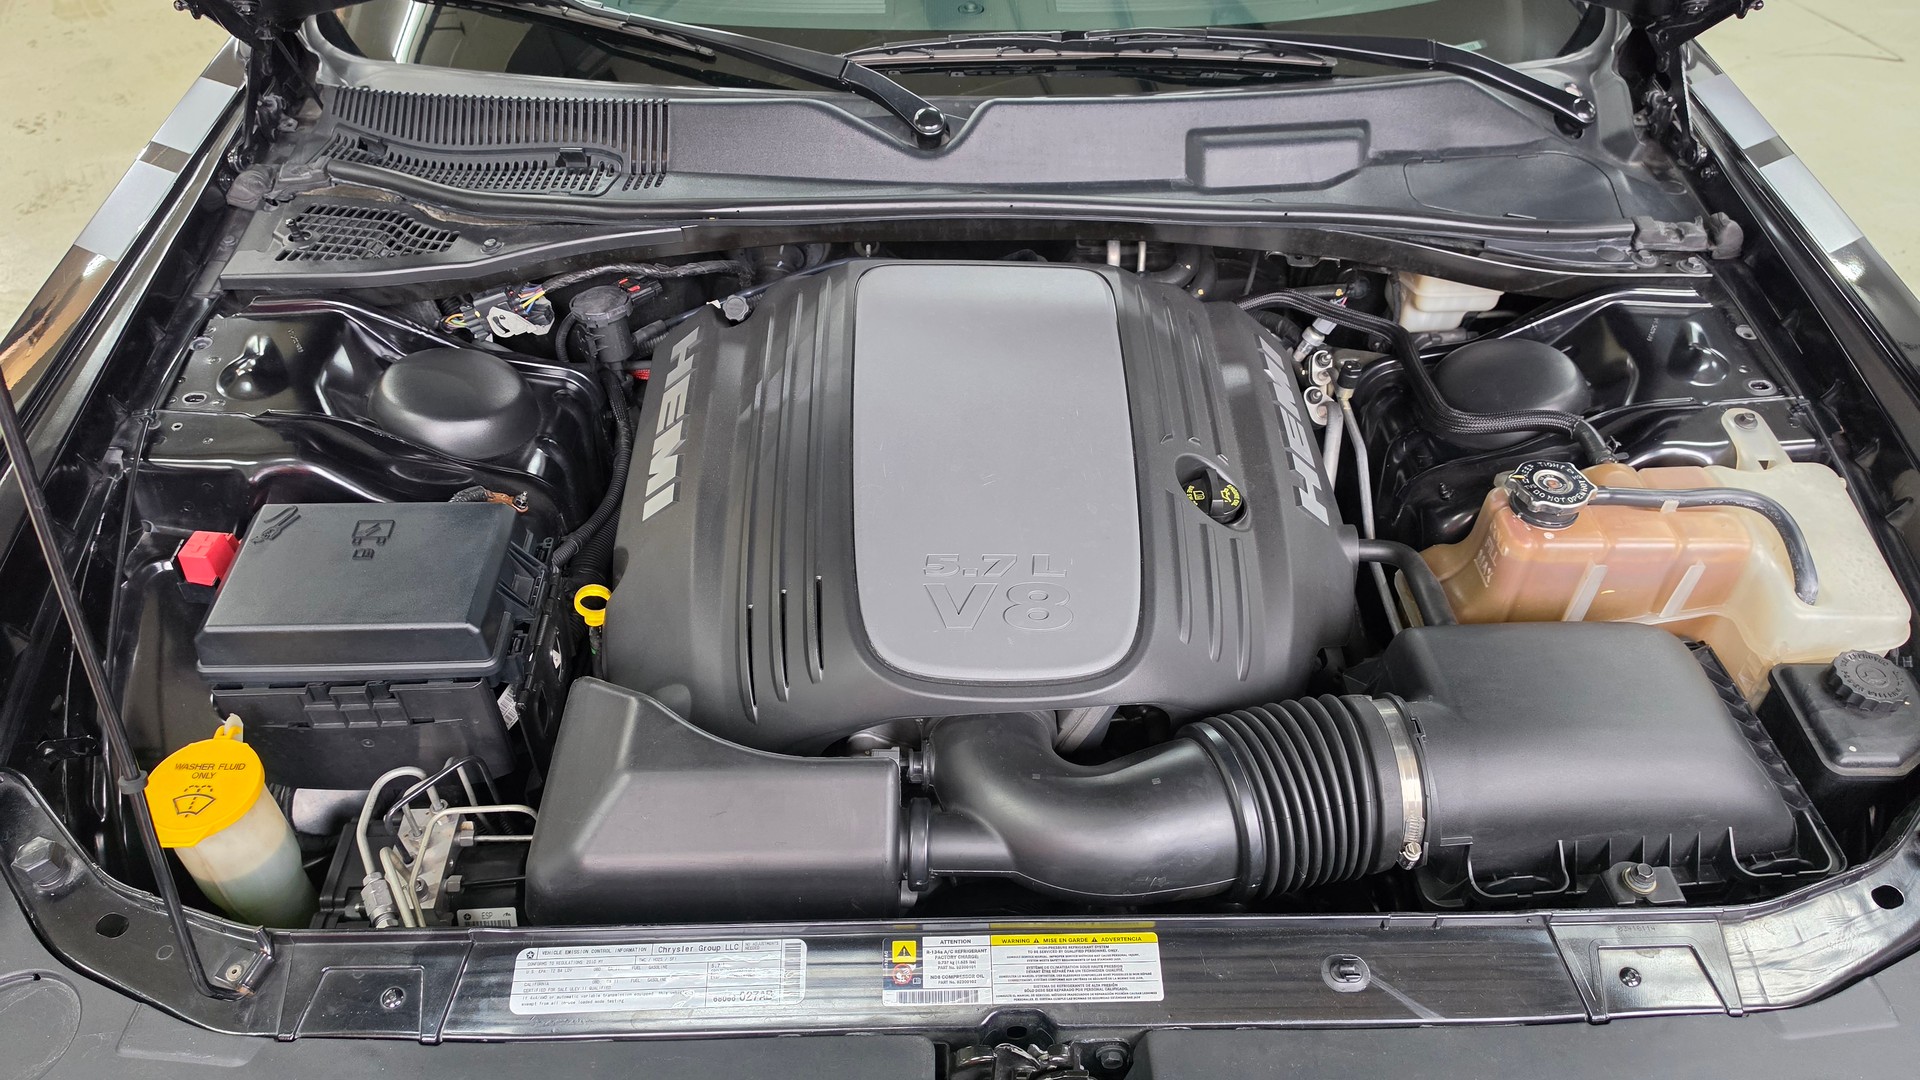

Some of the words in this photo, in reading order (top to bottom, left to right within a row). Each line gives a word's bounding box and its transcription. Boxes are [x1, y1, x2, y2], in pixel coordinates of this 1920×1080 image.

[642, 326, 700, 522] HEMI
[1258, 335, 1330, 526] HEMI
[1533, 490, 1546, 498] DO
[1567, 492, 1587, 502] OPEN
[923, 554, 1018, 578] 5.7
[1032, 554, 1068, 578] L
[923, 582, 1074, 630] V8
[658, 944, 693, 954] Chrysler
